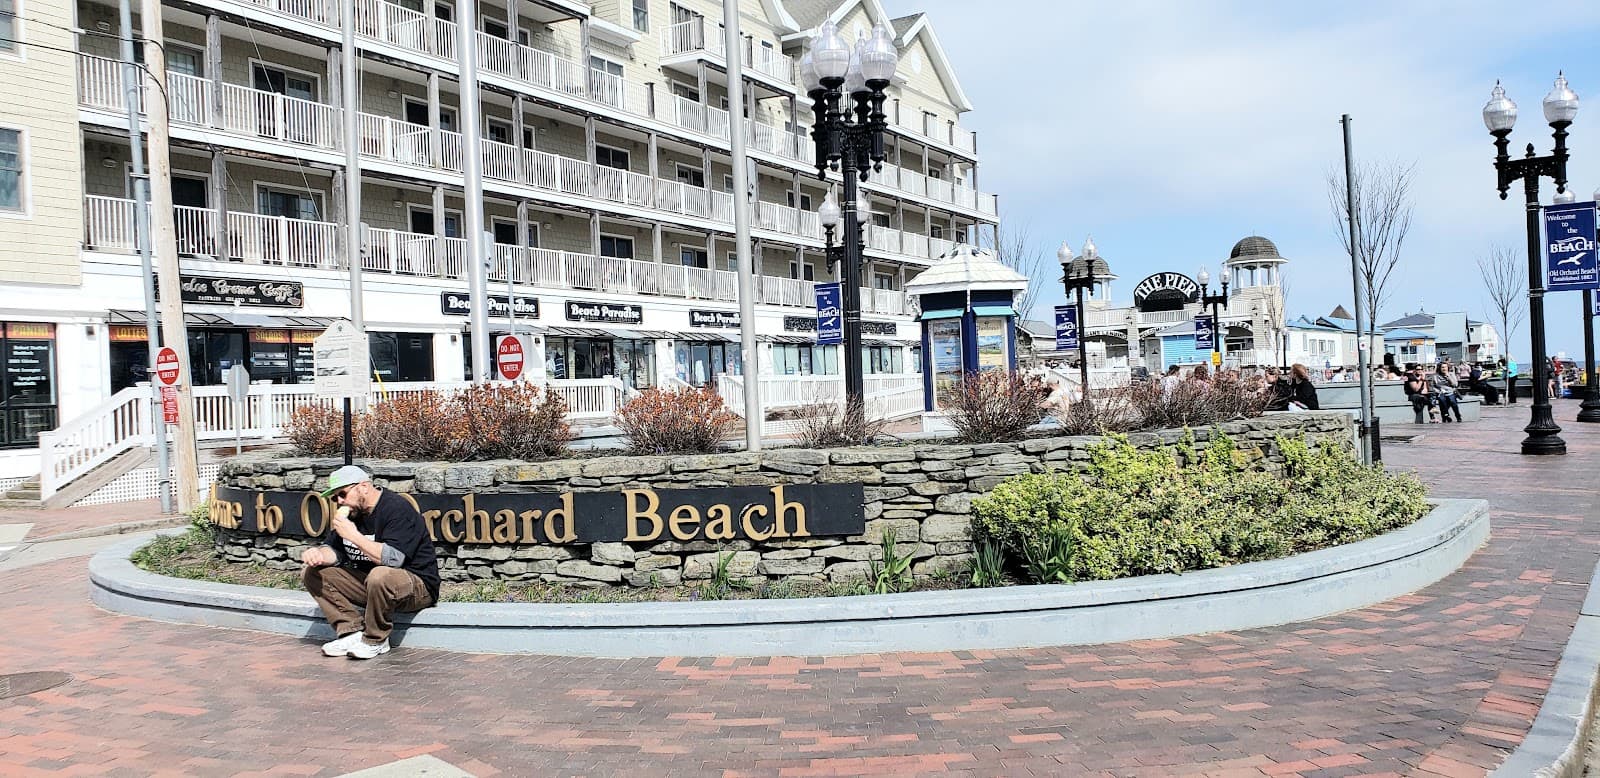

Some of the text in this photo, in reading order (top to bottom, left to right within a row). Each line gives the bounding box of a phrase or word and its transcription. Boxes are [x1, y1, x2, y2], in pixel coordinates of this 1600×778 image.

[1550, 240, 1594, 253] BEACH
[1559, 268, 1580, 276] Orchard
[1134, 273, 1197, 300] THE PIER
[448, 295, 535, 313] Bea Pardise
[571, 304, 599, 316] Beach
[602, 304, 640, 319] Paradise
[694, 312, 715, 322] Beach
[819, 309, 839, 318] BEACH
[255, 492, 283, 534] to
[301, 491, 338, 537] Ol
[620, 484, 811, 541] Beach
